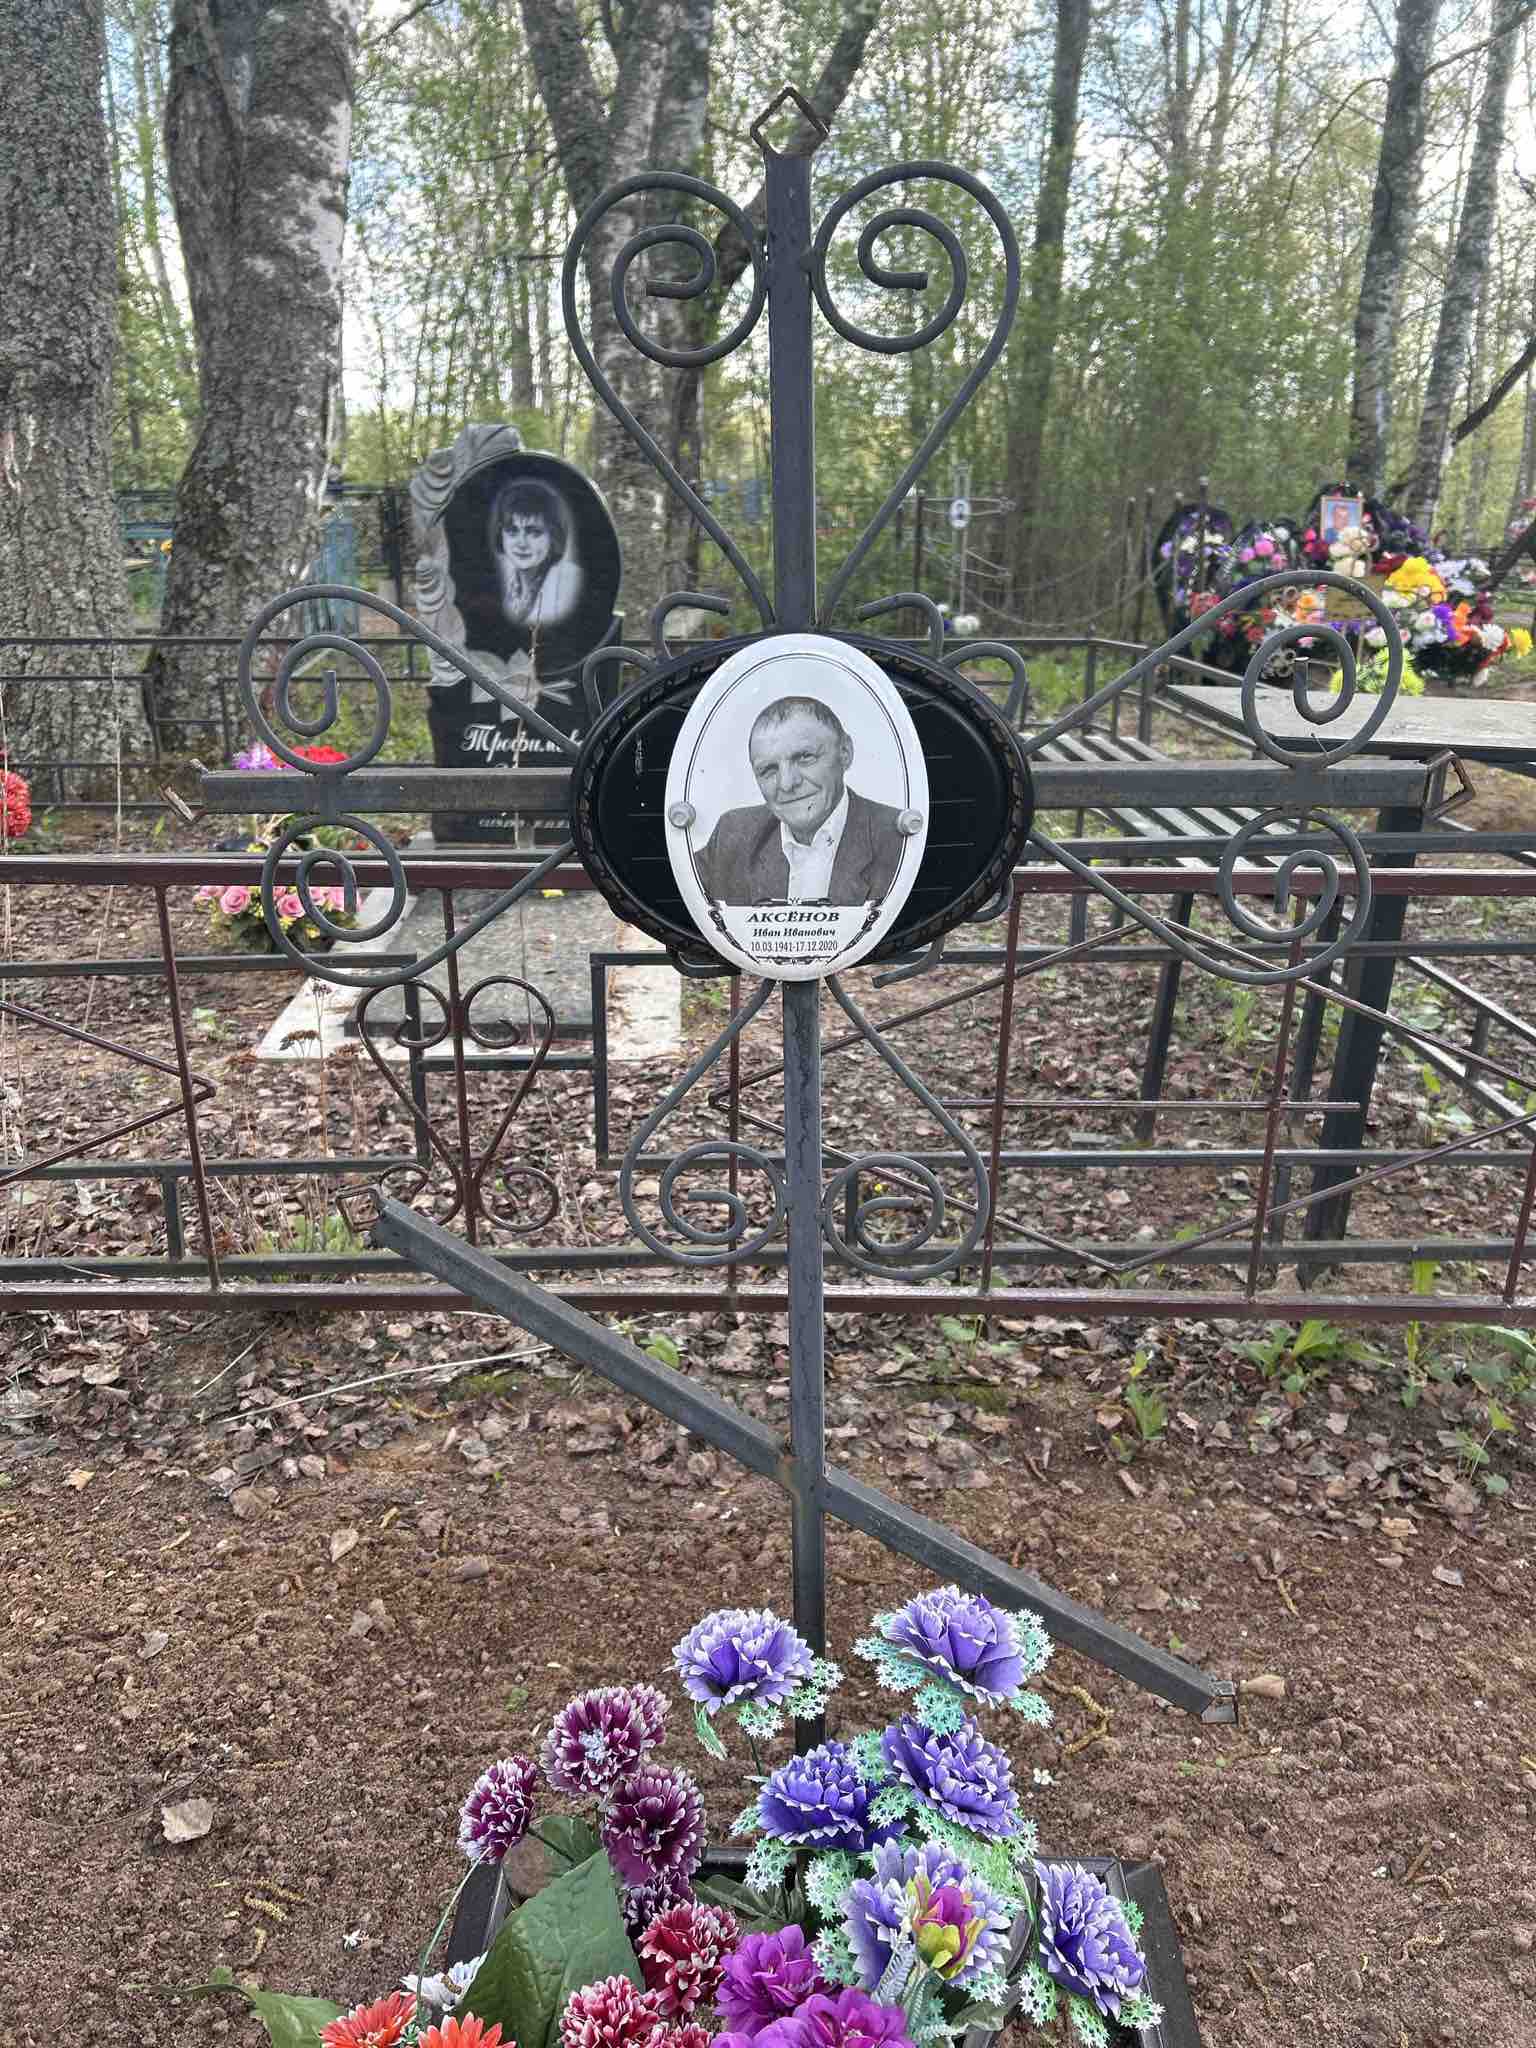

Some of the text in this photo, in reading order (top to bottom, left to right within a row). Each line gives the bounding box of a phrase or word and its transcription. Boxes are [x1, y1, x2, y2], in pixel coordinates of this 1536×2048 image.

[747, 910, 840, 923] АКСЁНОВ
[753, 927, 836, 937] Иван Иванович
[751, 940, 838, 952] 10.03.1941-17.12.2020
